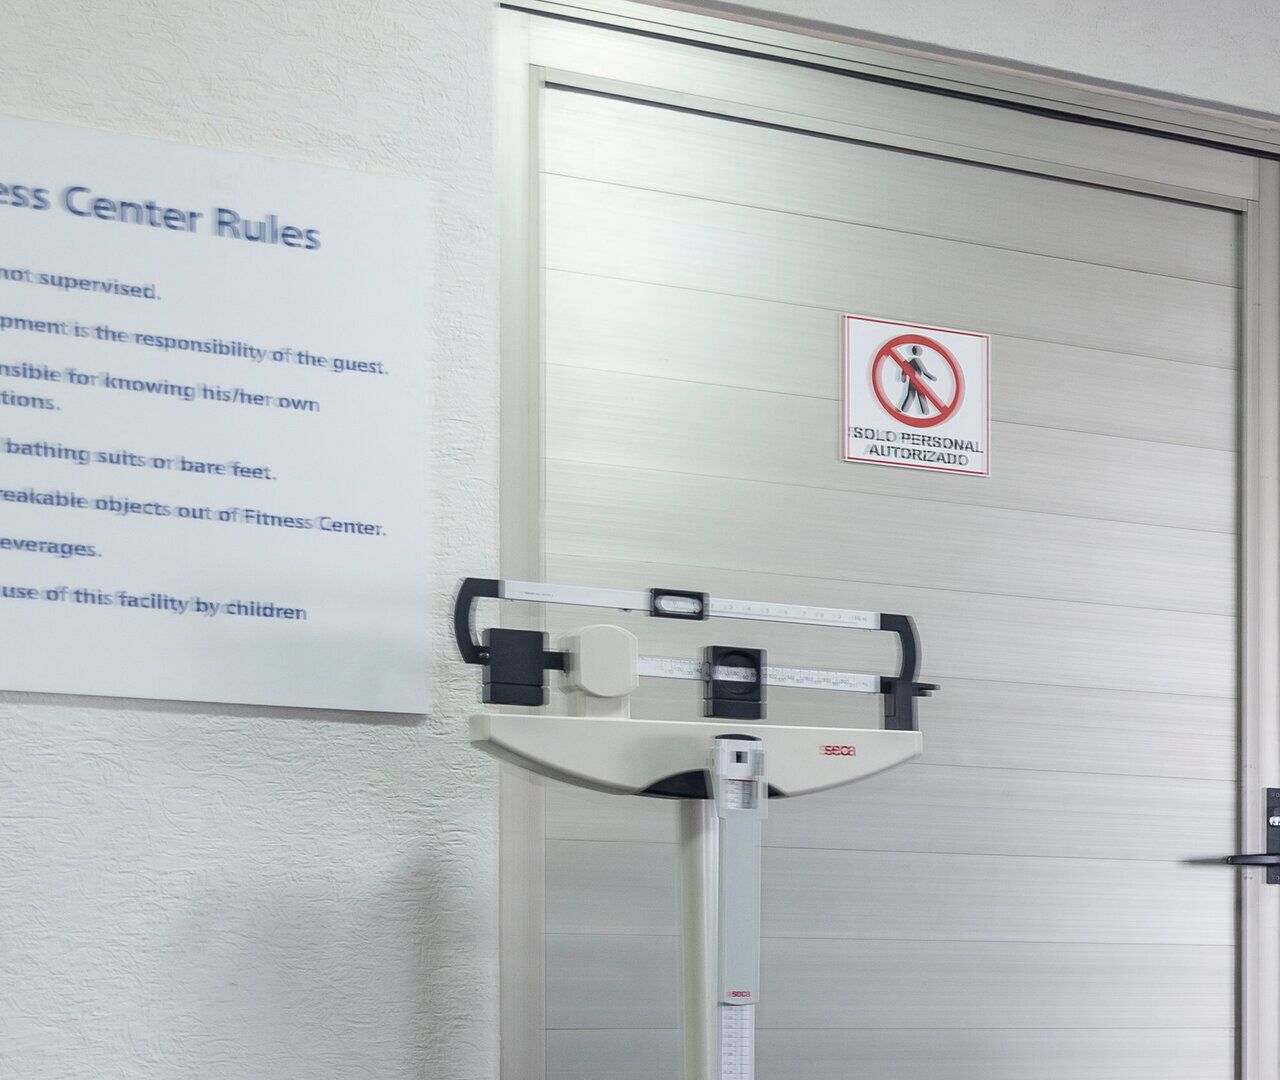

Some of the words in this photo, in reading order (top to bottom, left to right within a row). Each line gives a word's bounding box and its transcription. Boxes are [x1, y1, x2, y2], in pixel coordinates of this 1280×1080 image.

[62, 185, 203, 233] Center
[213, 206, 321, 250] Rules
[38, 272, 161, 300] supervised.
[74, 320, 90, 338] is
[95, 323, 129, 344] the
[135, 332, 266, 363] responsibility
[272, 346, 292, 363] of
[296, 349, 328, 369] the
[332, 356, 389, 376] guest.
[65, 366, 99, 387] for
[104, 372, 195, 400] knowing
[201, 381, 273, 408] his/her
[278, 396, 320, 413] own
[850, 426, 897, 443] SOLO
[900, 431, 984, 454] PERSONAL
[866, 443, 969, 467] AUTORIZADO
[6, 437, 90, 465] bathing
[98, 446, 146, 468] suits
[153, 455, 175, 470] or
[180, 454, 226, 476] bare
[231, 460, 277, 481] feet.
[95, 495, 171, 518] objects
[178, 504, 212, 521] out
[219, 506, 241, 523] of
[244, 508, 313, 530] Fitness
[318, 515, 387, 537] Center.
[0, 536, 102, 559] everages.
[2, 585, 39, 600] use
[46, 585, 68, 602] of
[74, 587, 112, 606] this
[119, 590, 190, 615] facility
[194, 597, 220, 618] by
[226, 597, 307, 621] children
[820, 745, 856, 756] seca
